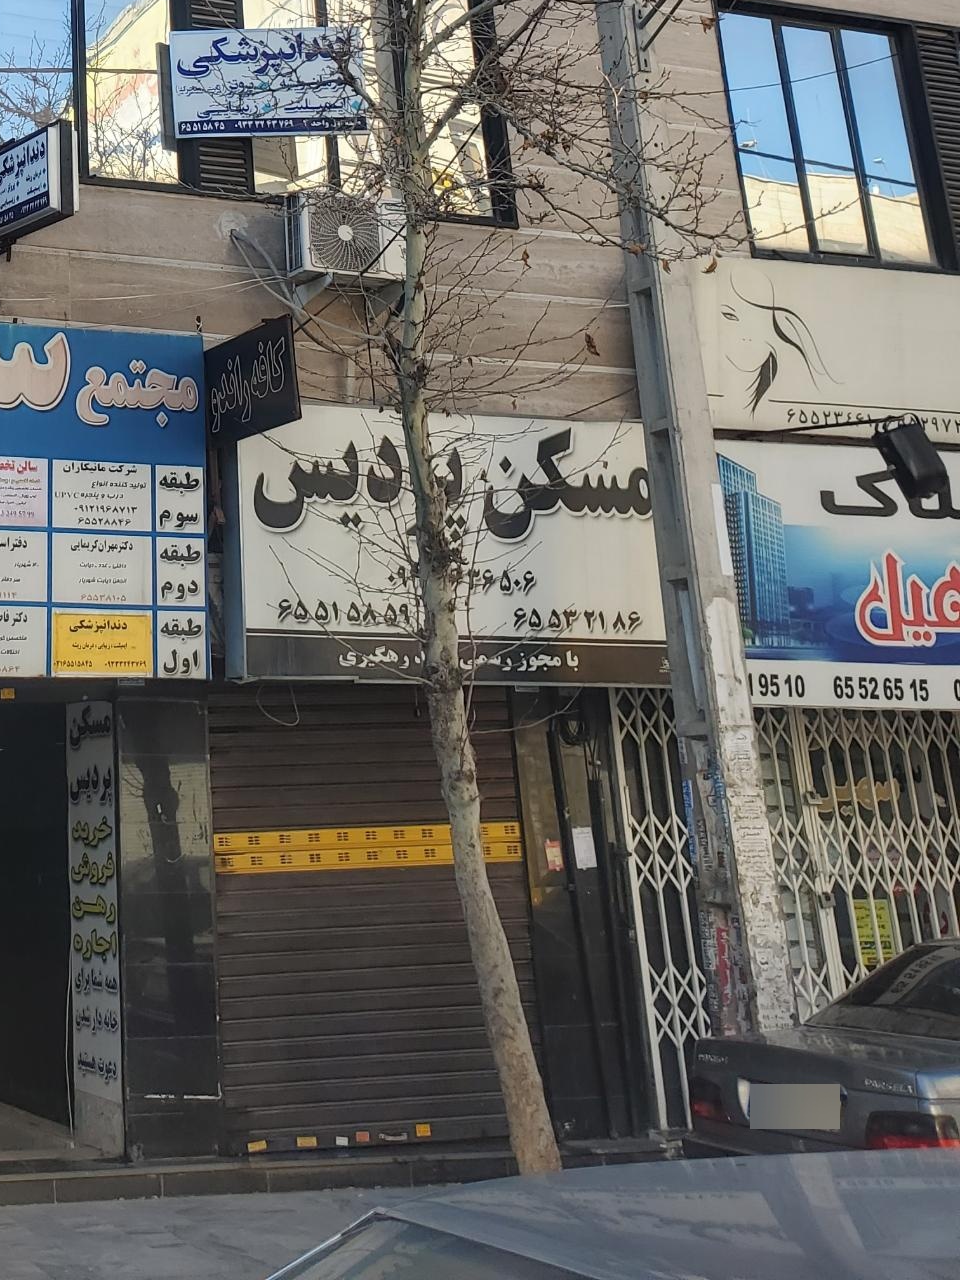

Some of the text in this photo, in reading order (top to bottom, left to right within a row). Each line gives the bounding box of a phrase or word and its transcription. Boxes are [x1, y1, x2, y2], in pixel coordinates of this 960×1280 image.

[75, 360, 200, 427] مجتمع
[108, 464, 138, 476] شرکت
[158, 471, 201, 497] طبقه
[253, 426, 653, 544] مسکن پدیس
[159, 508, 199, 528] سوم
[9, 536, 28, 551] دفتر
[159, 543, 201, 567] طبقه
[160, 579, 199, 600] دوم
[160, 617, 202, 642] طبقه
[163, 649, 198, 674] اول
[516, 652, 562, 671] مجوز
[564, 649, 579, 671] با
[833, 675, 929, 702] 65 52 65 15
[69, 705, 112, 750] مسکن
[71, 814, 113, 850] خرید
[70, 848, 115, 885] فروش
[71, 892, 116, 923] رهن
[73, 928, 117, 961] اجاره
